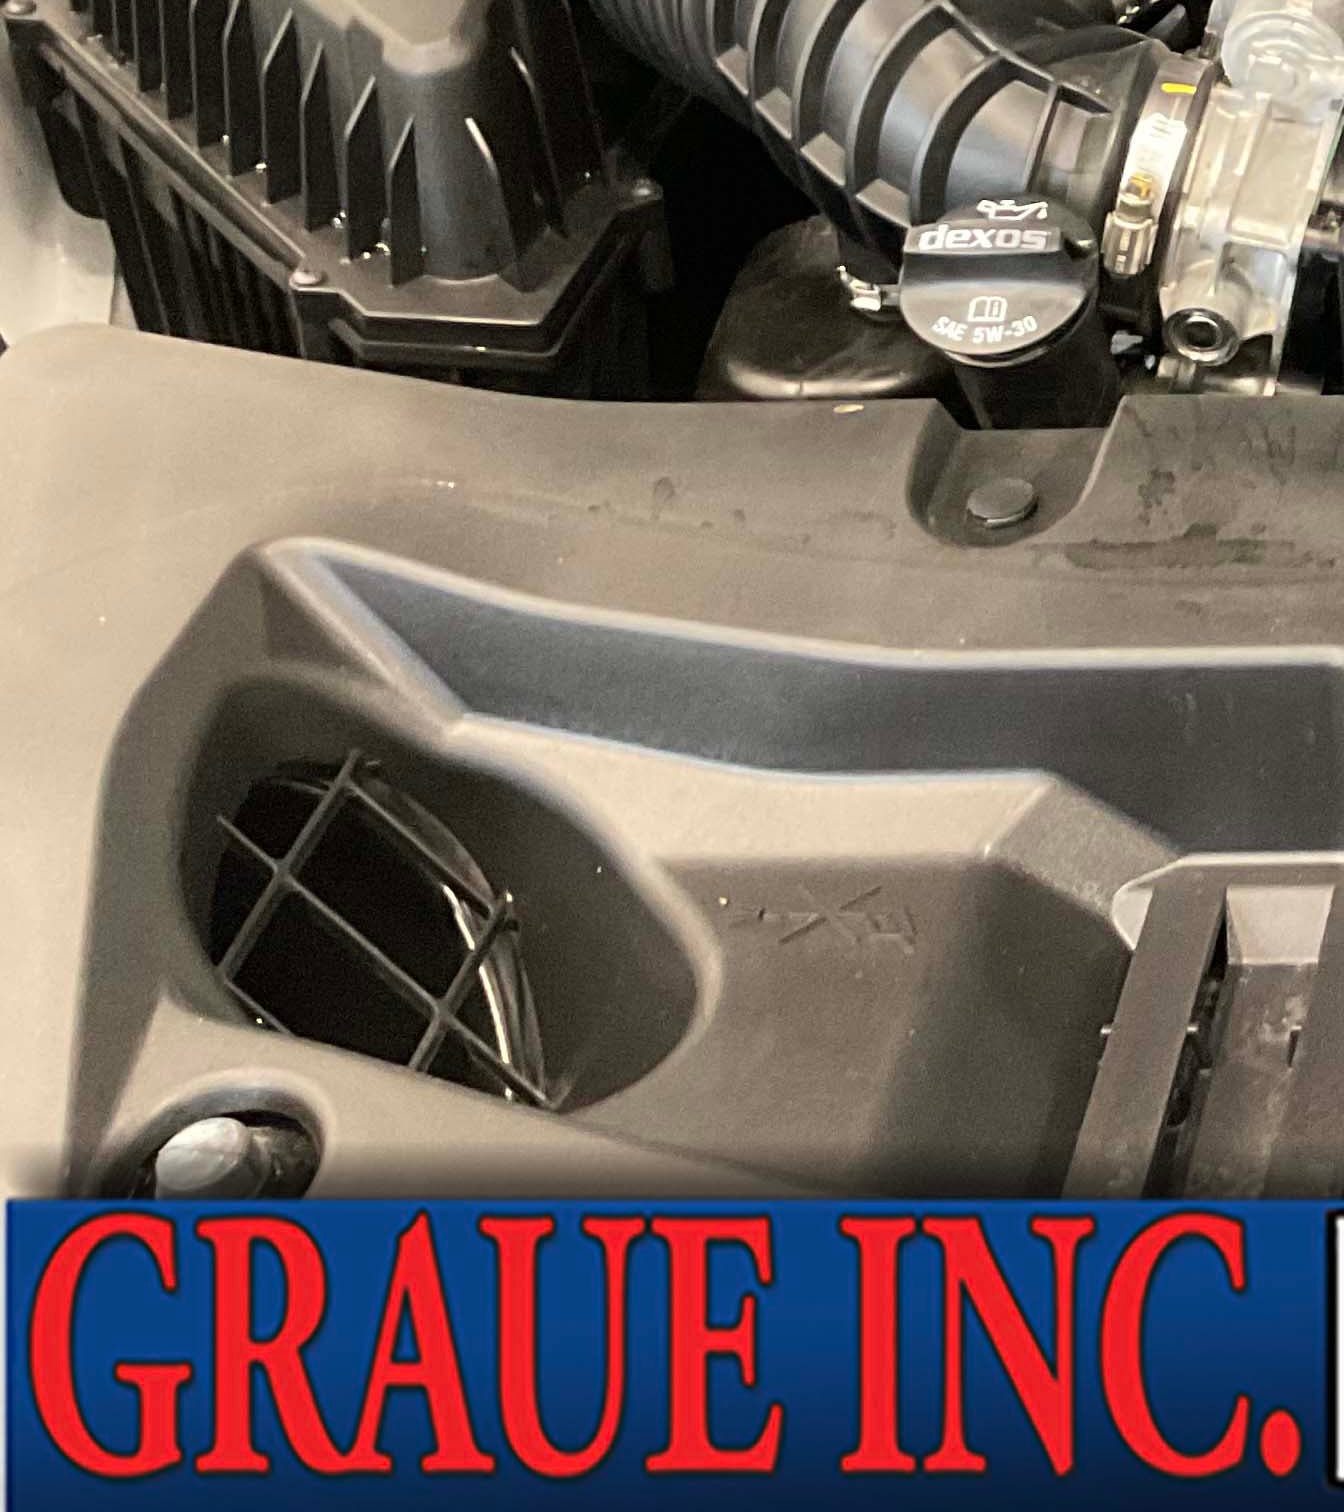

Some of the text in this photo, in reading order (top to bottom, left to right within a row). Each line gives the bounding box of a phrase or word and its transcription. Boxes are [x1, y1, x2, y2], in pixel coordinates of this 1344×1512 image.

[918, 224, 1051, 250] dexos
[932, 315, 1038, 344] SAE 5W-30
